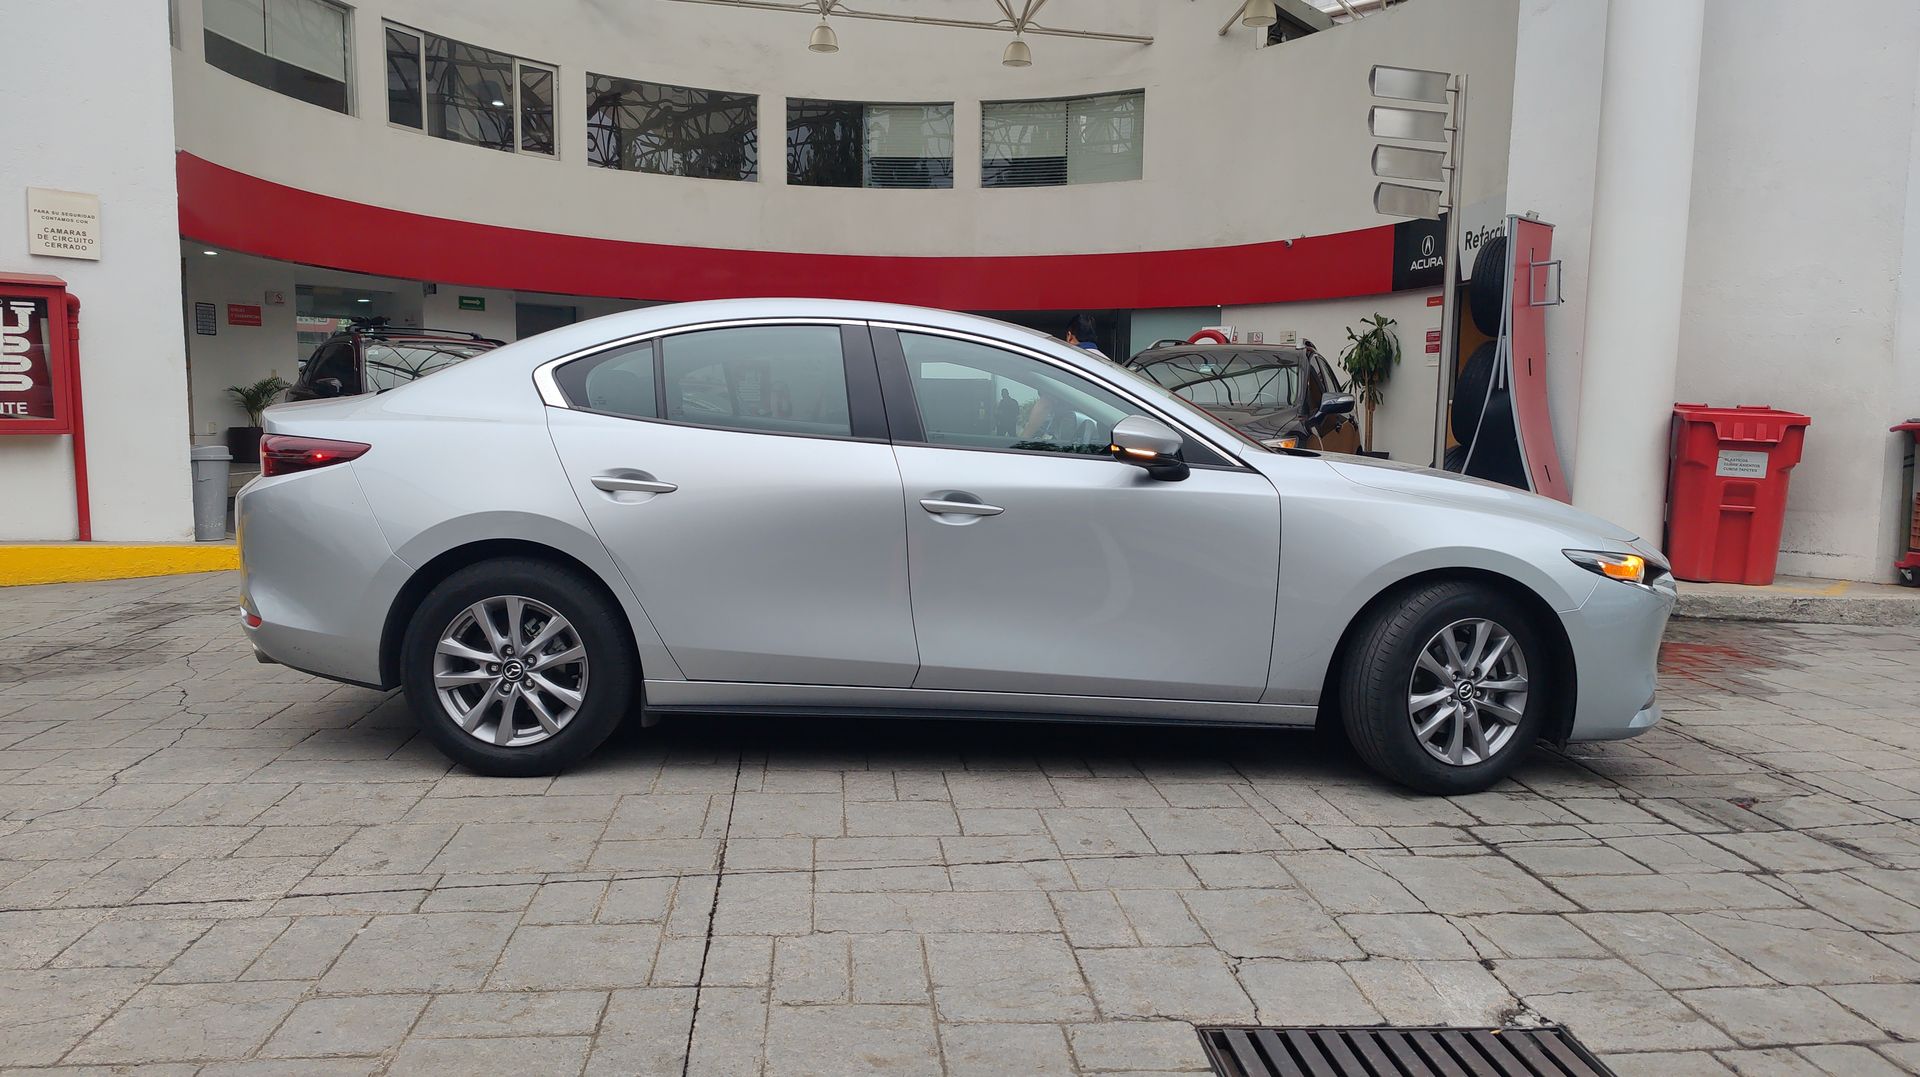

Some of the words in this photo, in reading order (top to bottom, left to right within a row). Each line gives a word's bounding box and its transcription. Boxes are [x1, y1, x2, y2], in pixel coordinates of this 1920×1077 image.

[41, 215, 74, 223] CONTAMOS
[61, 211, 96, 220] SEGURIDAD
[43, 227, 87, 237] CAMARAS
[37, 233, 49, 241] DE
[52, 235, 94, 245] CIRCUITO
[44, 241, 87, 251] CERRADO
[1410, 256, 1444, 271] ACURA
